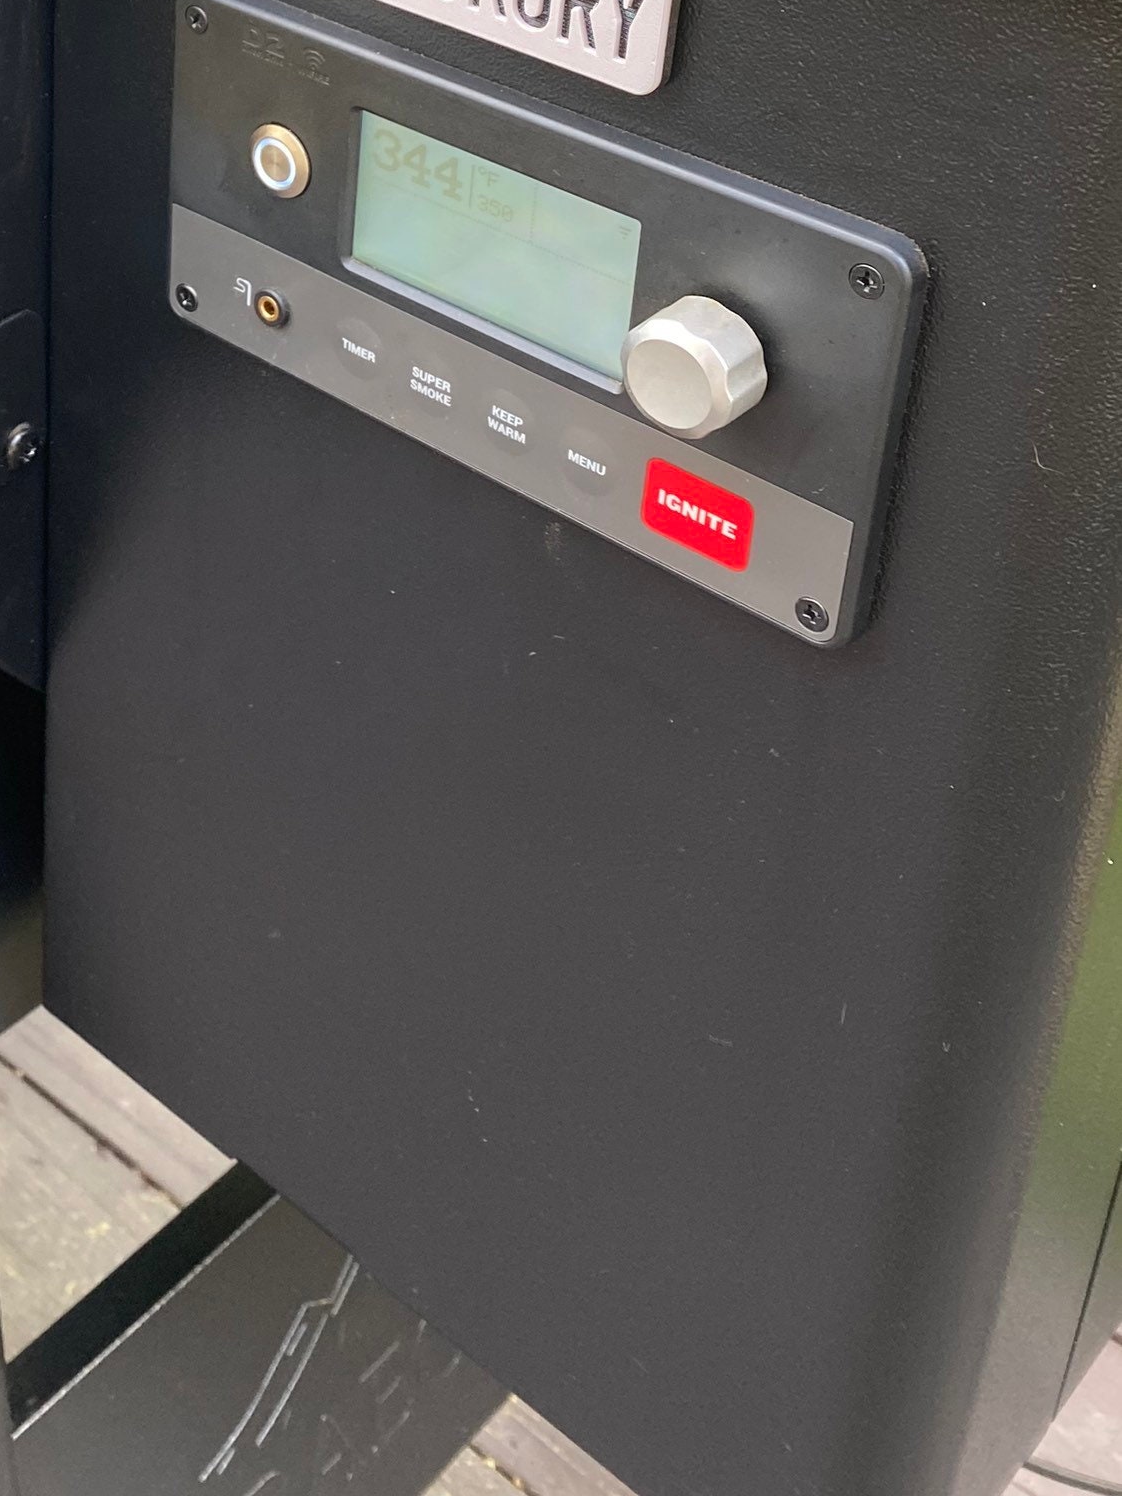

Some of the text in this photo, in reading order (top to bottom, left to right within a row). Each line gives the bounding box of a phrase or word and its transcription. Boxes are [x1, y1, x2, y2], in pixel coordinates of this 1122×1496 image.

[373, 128, 463, 202] 344
[476, 194, 515, 222] 350
[341, 336, 377, 365] TIMER
[409, 377, 453, 408] SMOKE
[411, 365, 452, 394] SUPER
[486, 415, 527, 446] WARM
[491, 404, 525, 428] KEEP
[567, 448, 608, 478] MENU
[656, 488, 739, 541] IGNITE
